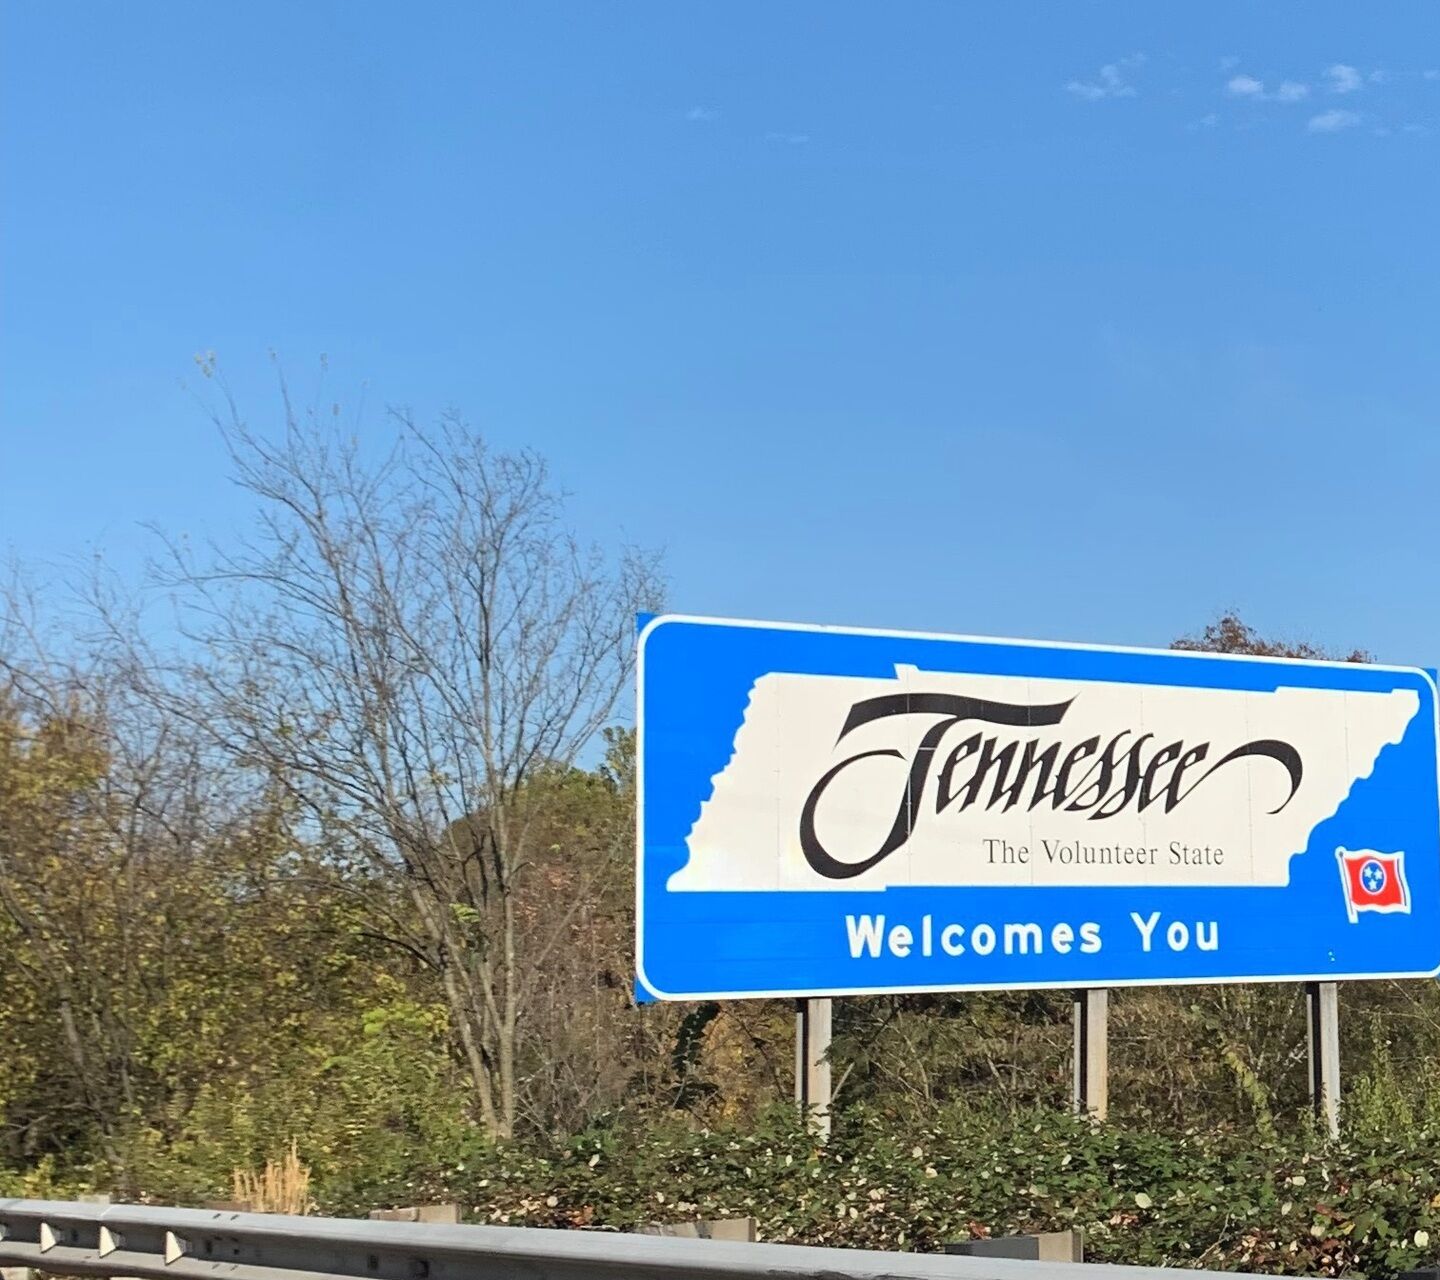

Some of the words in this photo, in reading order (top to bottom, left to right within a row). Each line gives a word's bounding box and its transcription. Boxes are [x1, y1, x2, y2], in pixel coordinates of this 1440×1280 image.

[800, 692, 1304, 880] Tennessee
[983, 838, 1030, 865] The
[1041, 839, 1159, 866] Volunteer
[1168, 840, 1225, 866] State
[845, 913, 1103, 959] Welcomes
[1129, 911, 1219, 953] You
